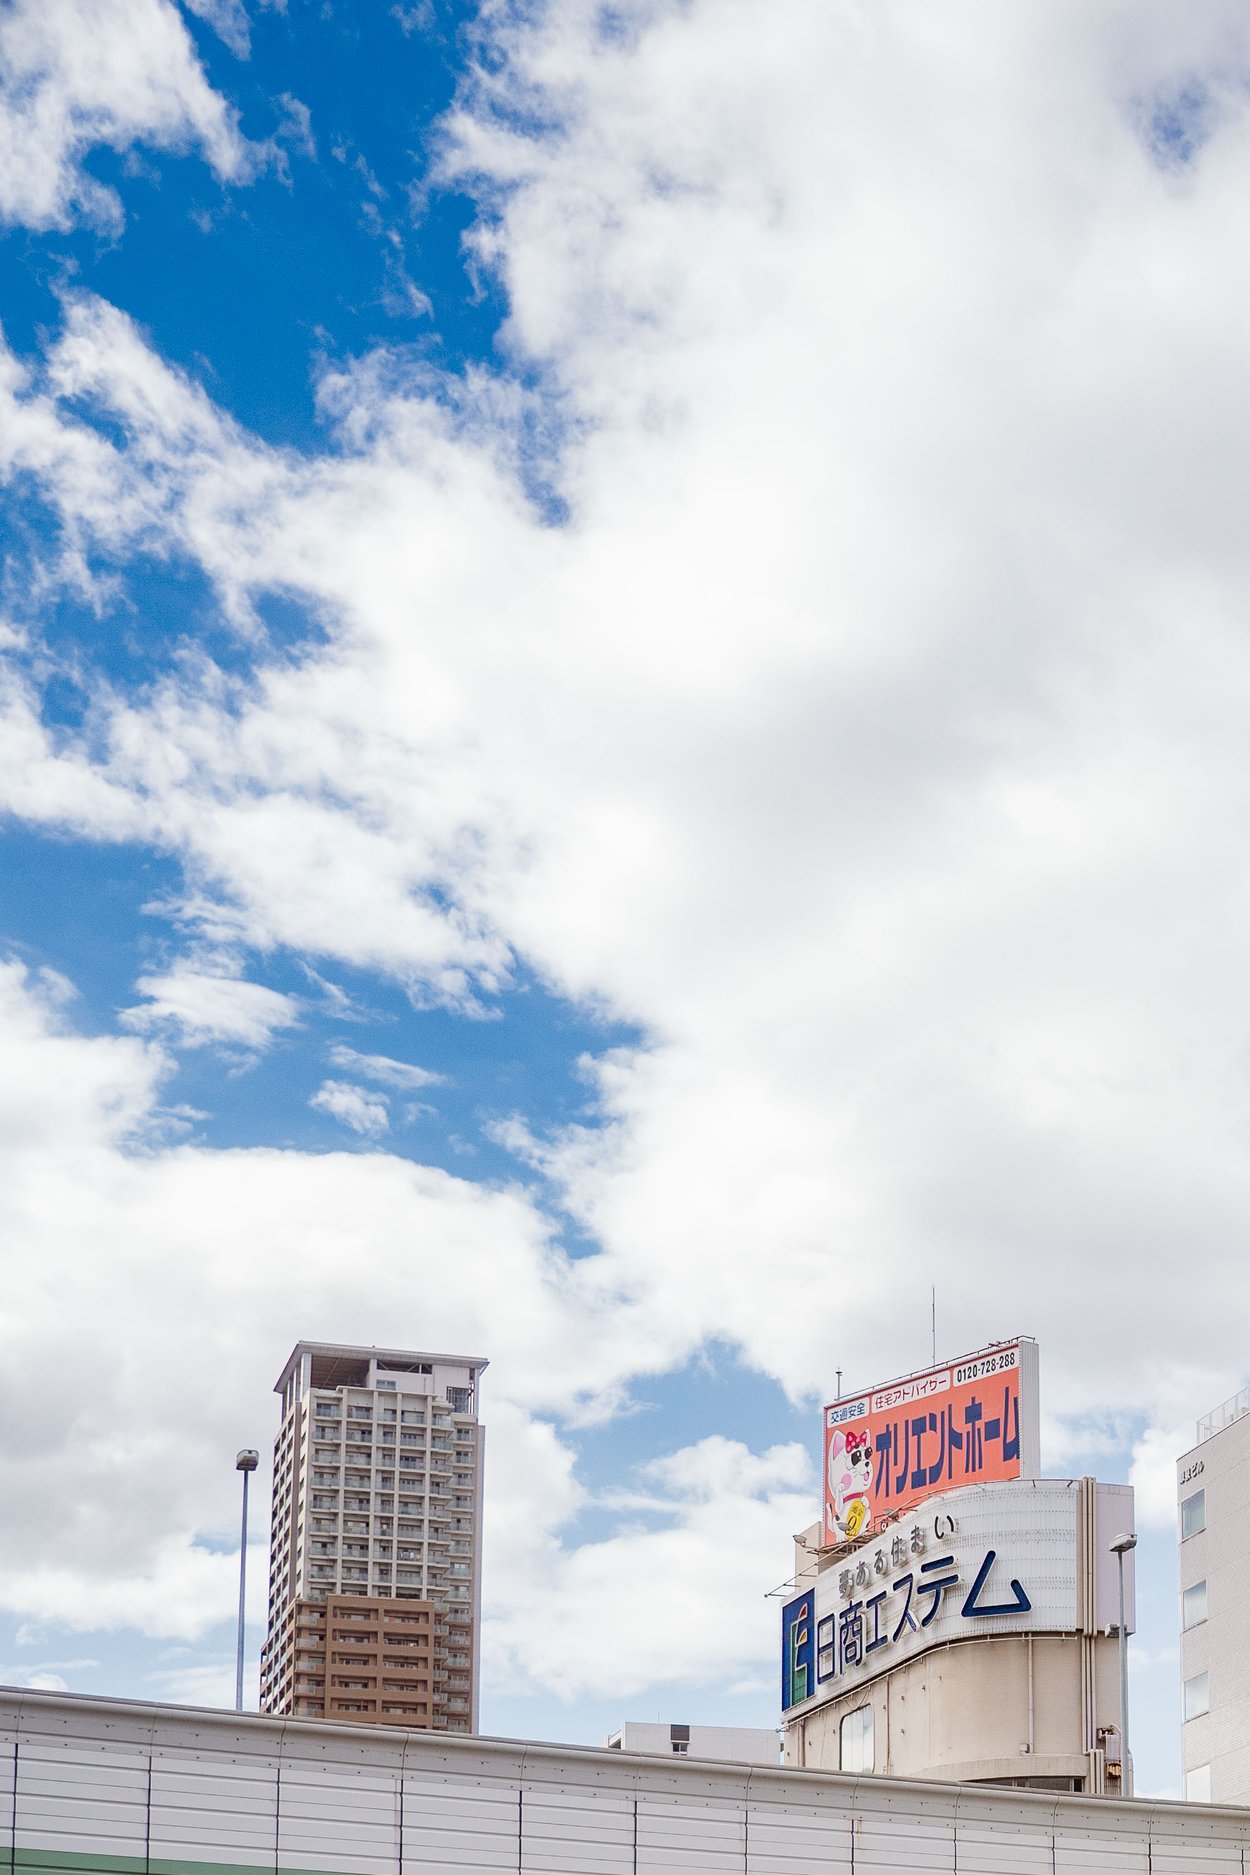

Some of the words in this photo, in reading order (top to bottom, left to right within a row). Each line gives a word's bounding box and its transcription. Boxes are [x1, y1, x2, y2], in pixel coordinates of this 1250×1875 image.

[874, 1377, 948, 1410] 住宅アドバイザー
[956, 1352, 1016, 1383] 0120-728-288
[830, 1402, 866, 1425] 交通安全
[875, 1386, 1021, 1499] オリエントホーム
[838, 1515, 955, 1599] 夢ある住まい
[817, 1550, 1032, 1686] 日商エステム
